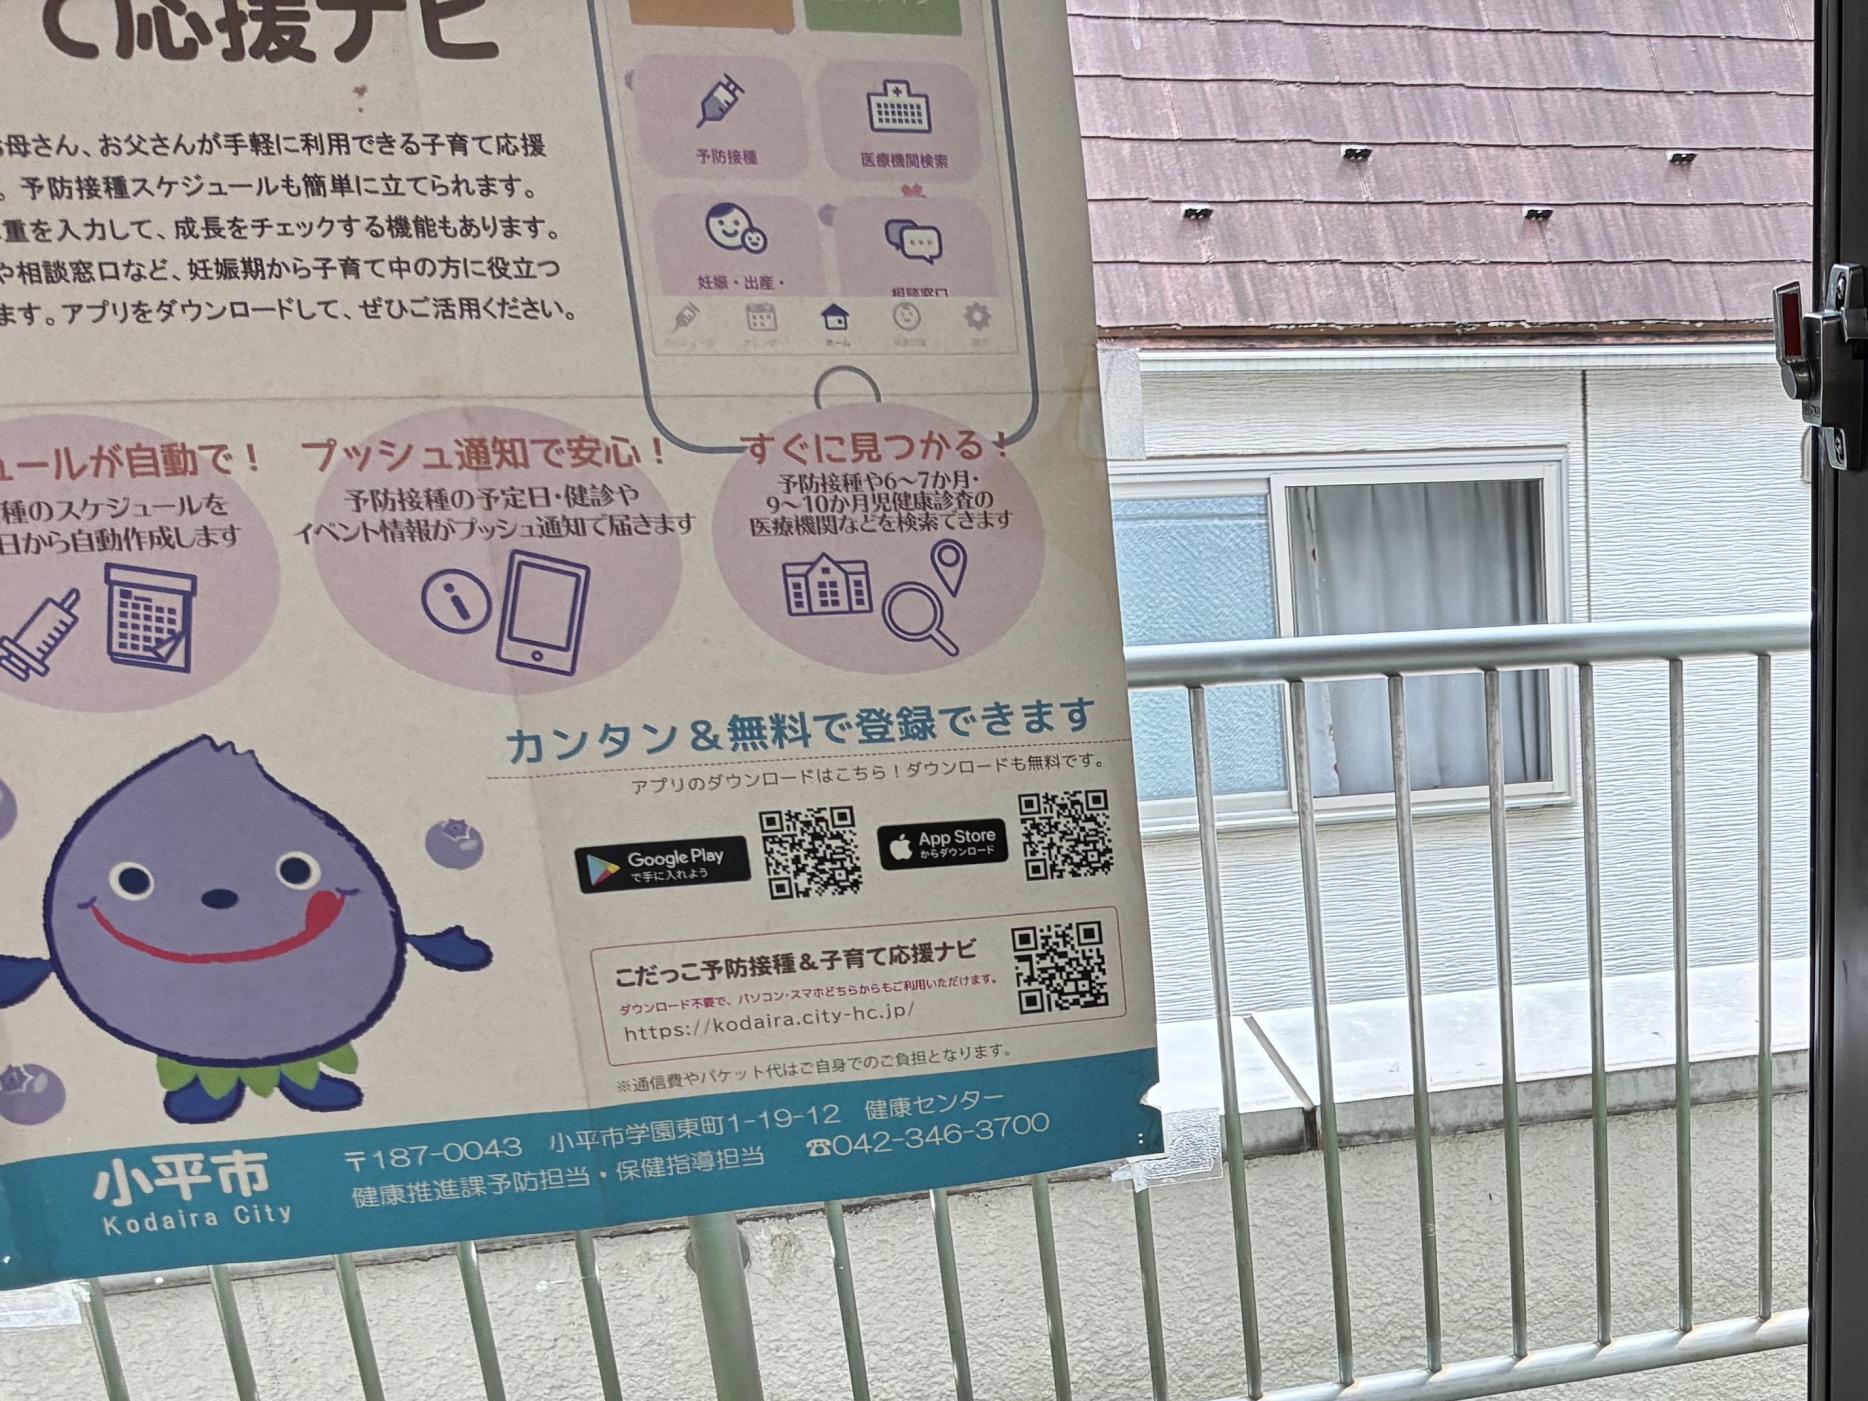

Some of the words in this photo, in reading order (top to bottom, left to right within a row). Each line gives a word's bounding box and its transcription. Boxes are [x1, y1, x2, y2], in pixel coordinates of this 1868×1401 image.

[0, 132, 547, 159] 母さん、お父さんが手軽に利用できる子育て応援
[696, 150, 758, 166] 予防接種
[861, 153, 948, 169] 医療機関検索
[302, 433, 667, 473] プッシュ通知で安心！
[741, 430, 1009, 465] すぐに見つかる！
[345, 483, 639, 514] 予防接種の予定日・健診や
[294, 512, 696, 545] イベント情報がプッシュ通知で届きます
[750, 510, 1014, 538] 医療機関などを検索できます
[919, 830, 950, 847] App
[954, 827, 996, 845] Store
[920, 845, 994, 859] からダウンロード
[628, 848, 686, 869] Google
[690, 847, 724, 867] Play
[630, 867, 708, 883] で手に入れよう
[615, 938, 978, 988] こだっこ予防接種＆子育て応援ナビ
[625, 1000, 916, 1044] https://kodaira.city-hc.jp/
[549, 1103, 841, 1154] 小平市学園東町1-19-12
[865, 1089, 1004, 1122] 健康センター
[93, 1149, 269, 1207] 小平市
[352, 1147, 764, 1209] 健康推進課予防担当・保健指導担当
[103, 1210, 219, 1236] Kodaira
[233, 1203, 293, 1225] City
